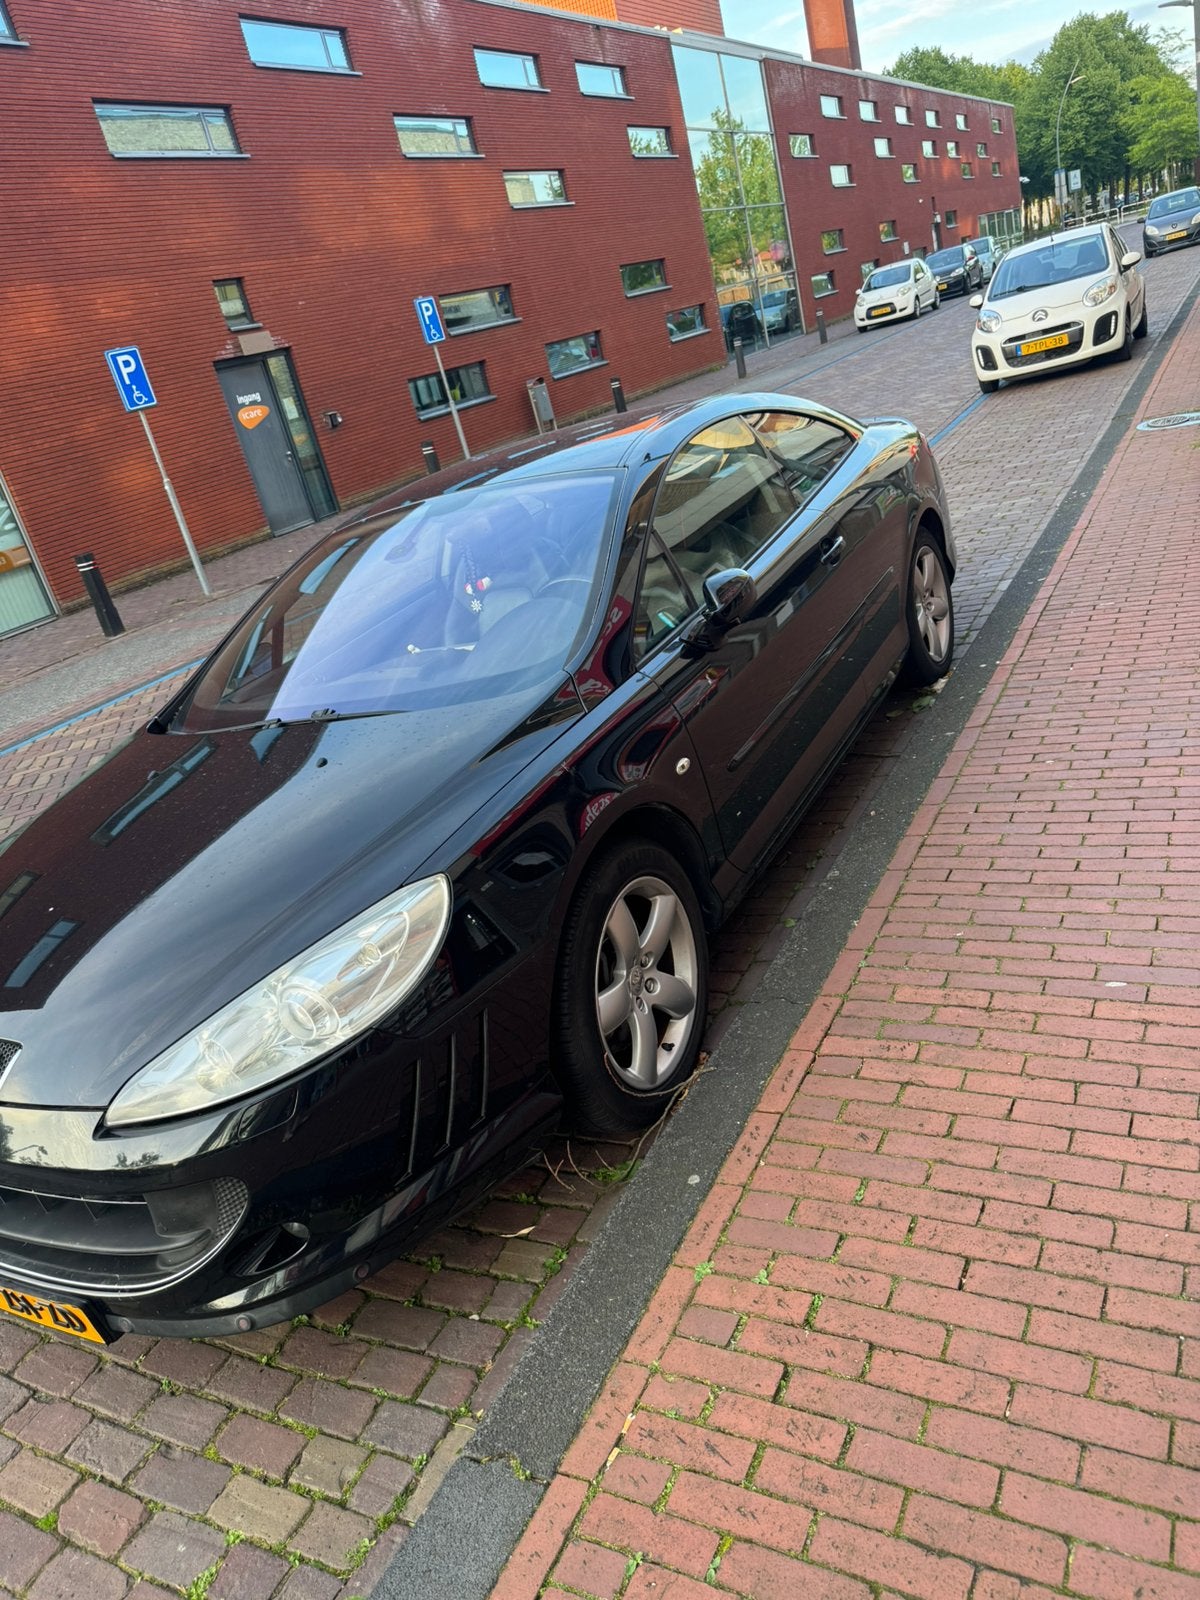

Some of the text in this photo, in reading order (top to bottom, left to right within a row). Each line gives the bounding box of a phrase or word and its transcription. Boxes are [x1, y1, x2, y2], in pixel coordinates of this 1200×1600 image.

[420, 302, 433, 325] P
[1025, 336, 1064, 353] 7-TPL-38
[116, 354, 136, 385] P
[241, 408, 263, 420] icare
